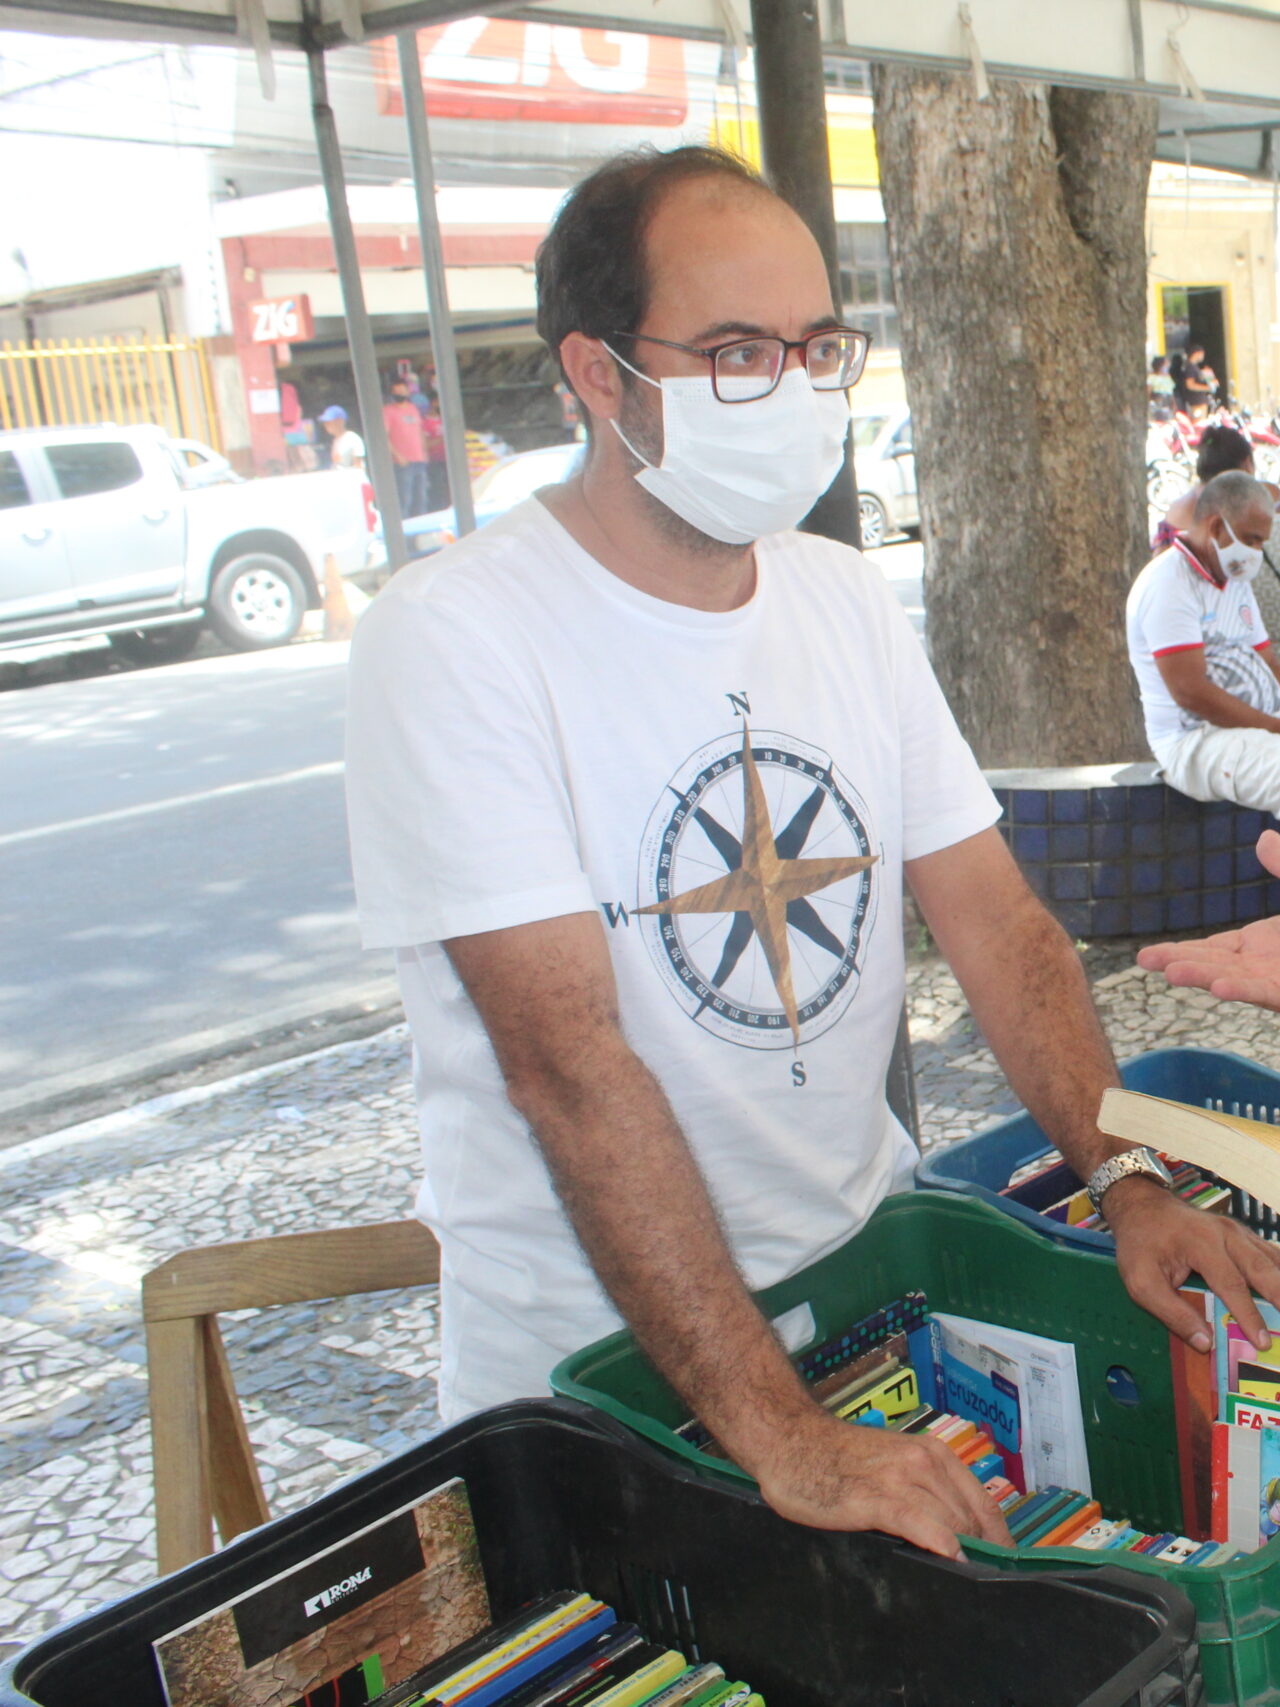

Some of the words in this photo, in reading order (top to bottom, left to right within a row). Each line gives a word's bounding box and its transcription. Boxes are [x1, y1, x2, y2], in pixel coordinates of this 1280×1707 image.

[422, 16, 651, 93] ZIG
[252, 300, 298, 341] ZIG
[725, 691, 751, 716] N
[601, 900, 630, 929] W
[791, 1061, 807, 1088] S
[328, 1566, 372, 1600] RONA
